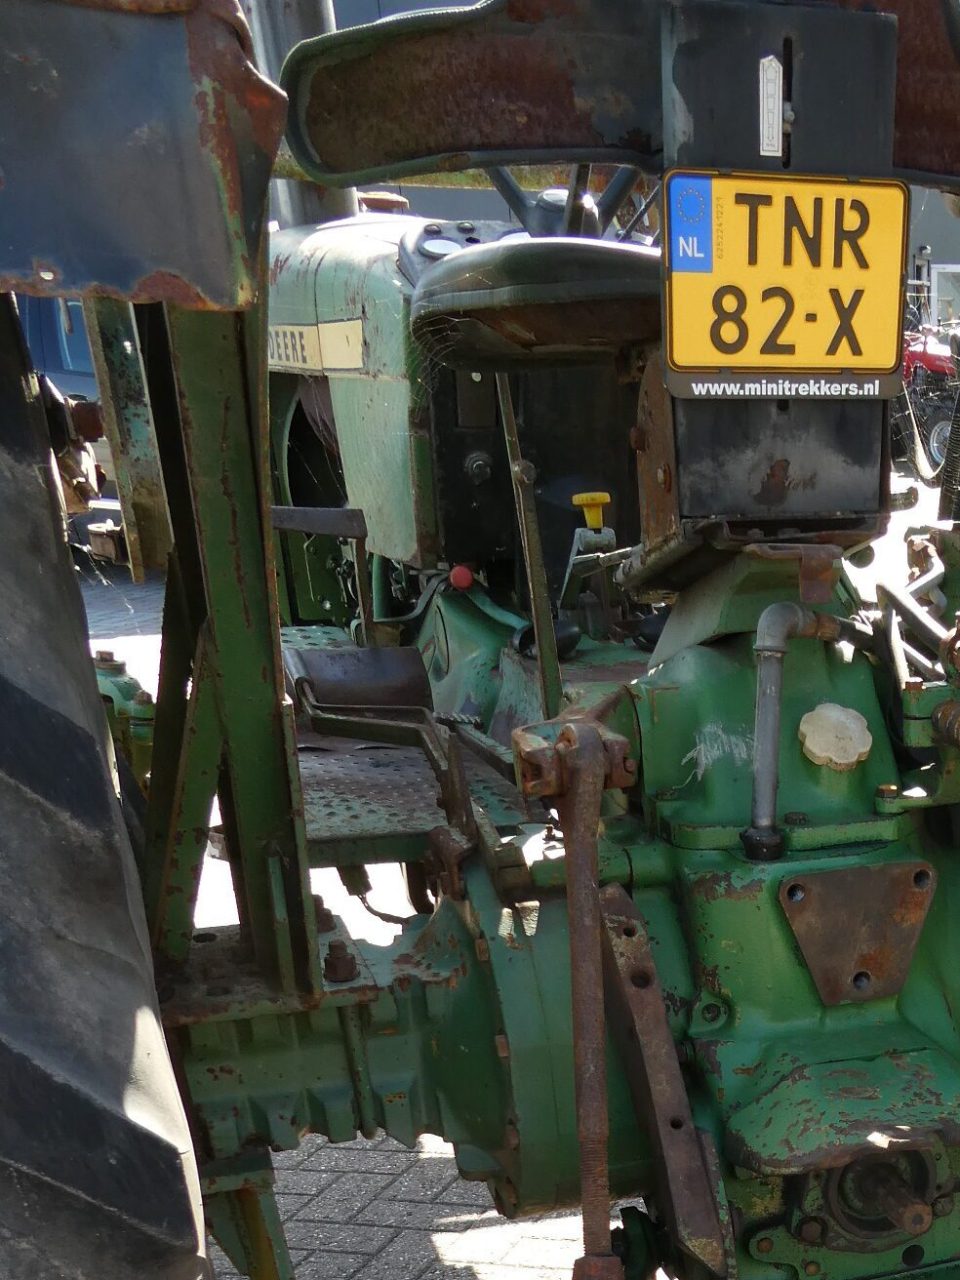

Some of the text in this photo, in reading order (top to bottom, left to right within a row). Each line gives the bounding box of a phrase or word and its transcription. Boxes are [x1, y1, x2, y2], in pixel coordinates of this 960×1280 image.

[679, 236, 705, 258] NL
[734, 192, 870, 270] TNR
[709, 284, 865, 356] 82-X
[691, 379, 880, 396] www.minitrekkers.nl
